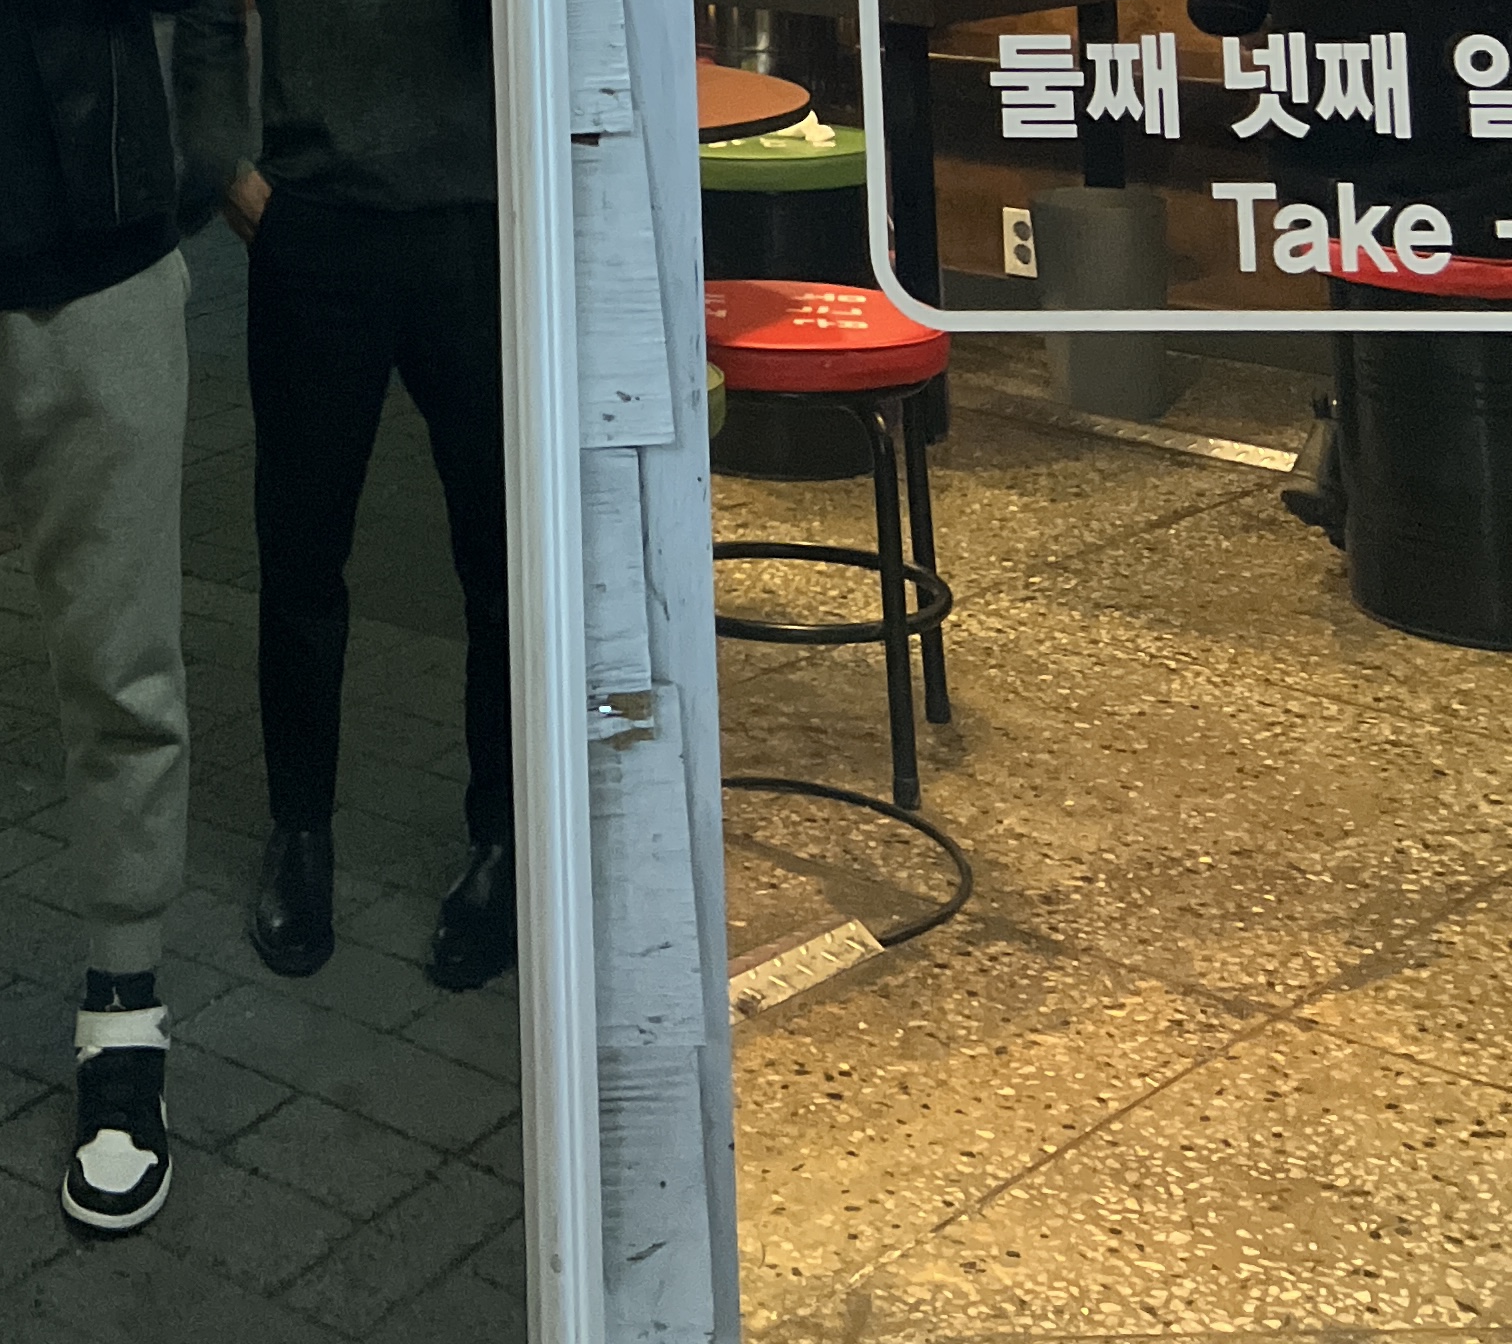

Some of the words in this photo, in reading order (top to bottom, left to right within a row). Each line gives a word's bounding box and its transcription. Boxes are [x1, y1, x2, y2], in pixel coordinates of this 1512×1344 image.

[990, 32, 1180, 139] 둘째
[1221, 32, 1412, 139] 넷째
[1212, 182, 1453, 275] Take
